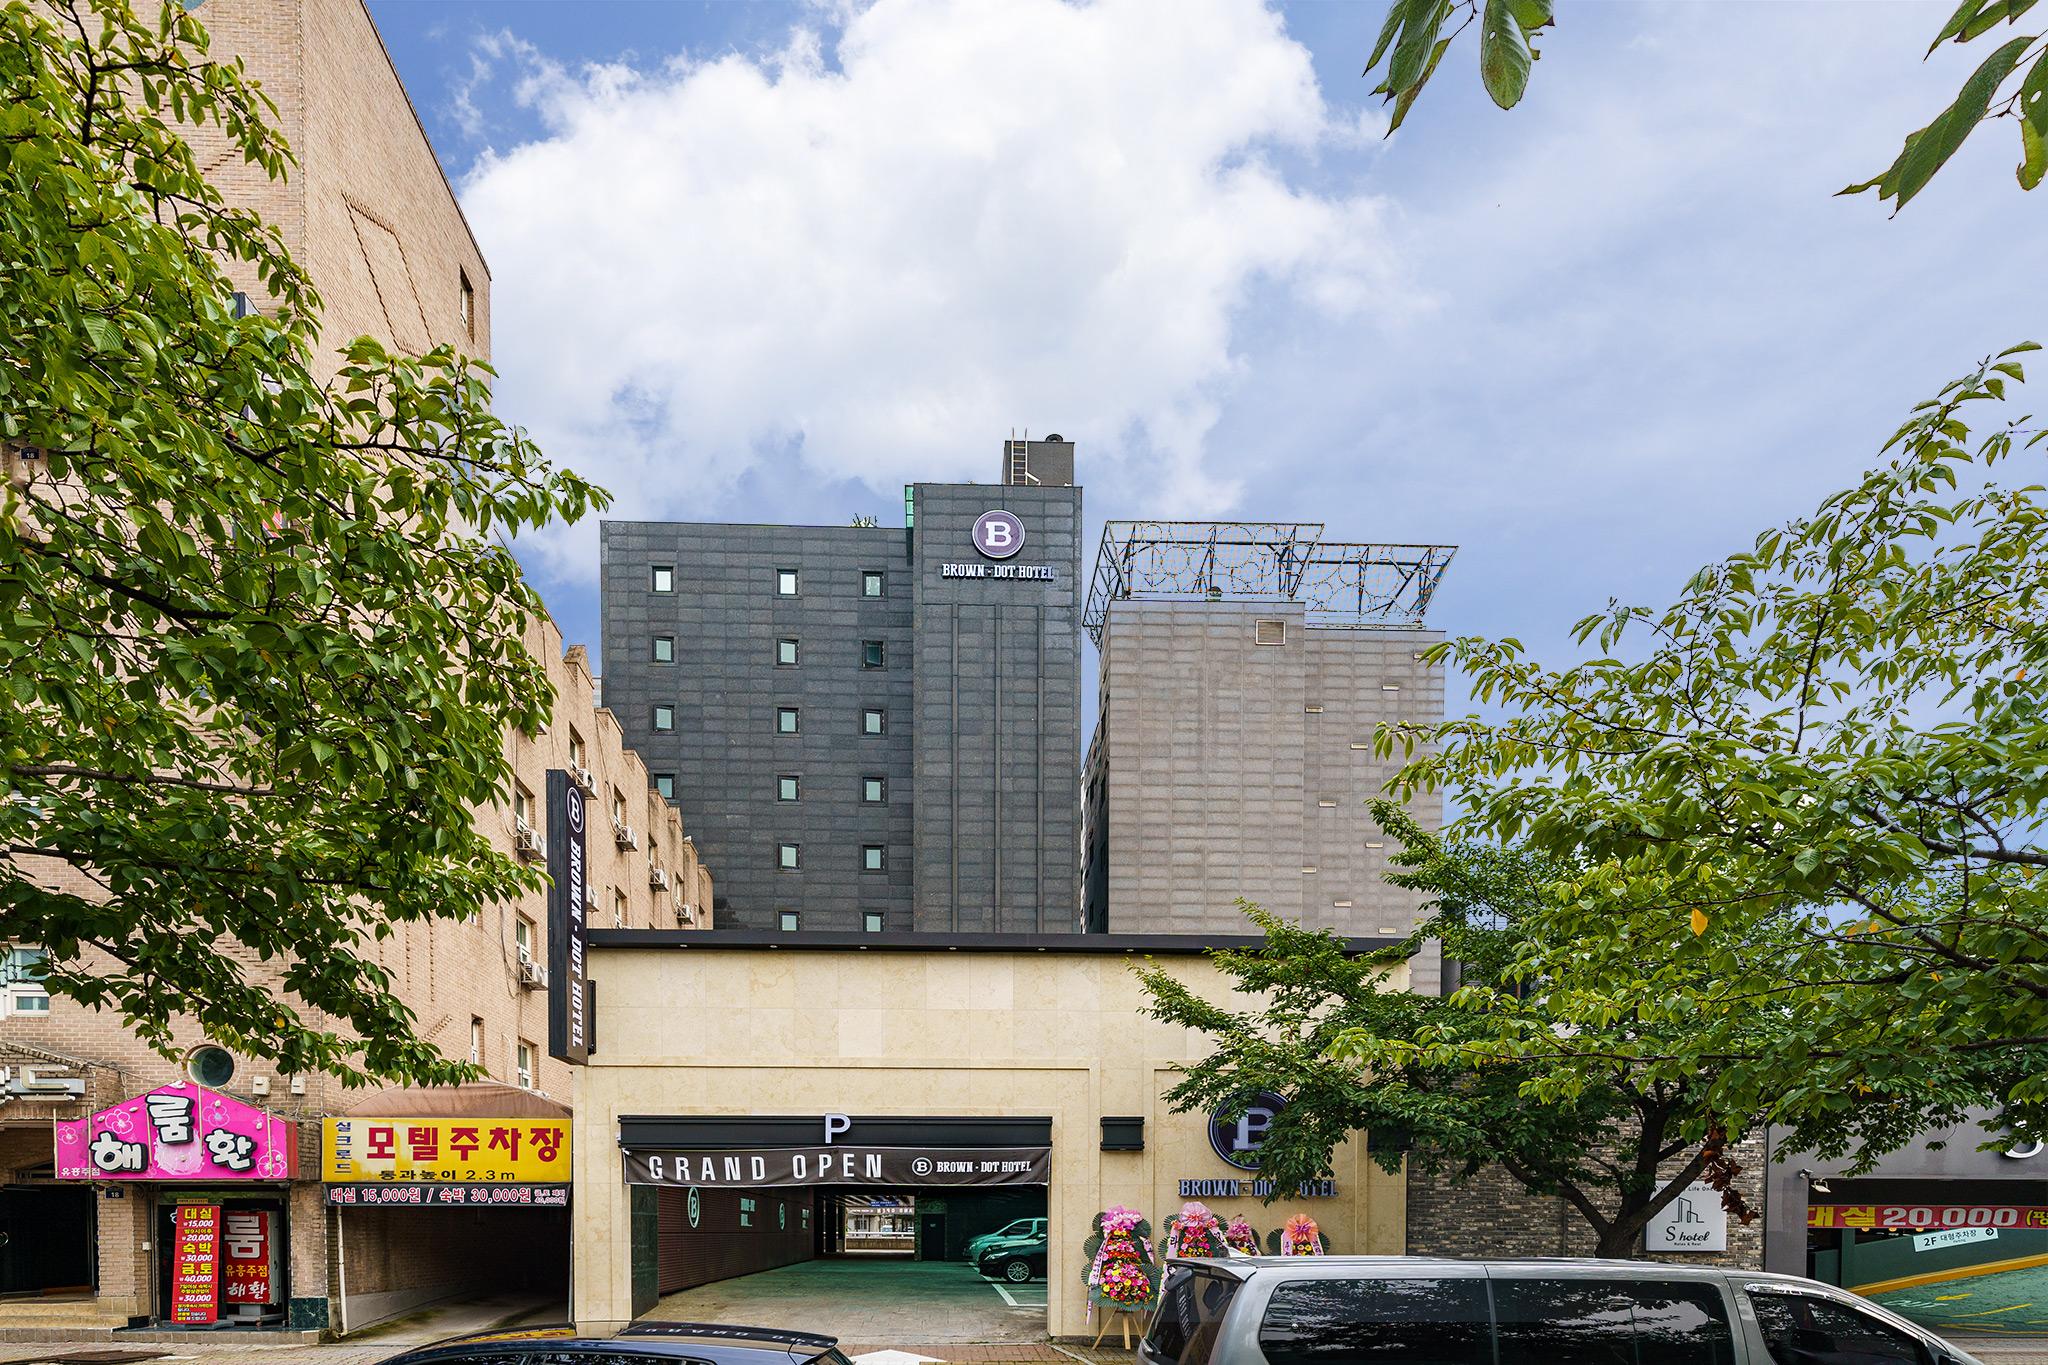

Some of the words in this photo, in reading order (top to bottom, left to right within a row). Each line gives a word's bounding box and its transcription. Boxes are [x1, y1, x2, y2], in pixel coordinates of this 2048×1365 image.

[985, 521, 1012, 547] B
[942, 563, 985, 577] BROWN
[993, 564, 1015, 578] DOT
[1018, 565, 1054, 579] HOTEL
[570, 836, 582, 924] BROWN
[571, 934, 583, 980] DOT
[571, 980, 583, 1047] HOTEL
[825, 1113, 851, 1144] P
[335, 1121, 352, 1173] 실크로드
[366, 1127, 564, 1162] 모텔주차장
[61, 1167, 100, 1176] 유흥주점
[379, 1169, 456, 1181] 통과높이
[649, 1155, 766, 1181] GRAND
[792, 1153, 882, 1179] OPEN
[936, 1161, 973, 1173] BROWN
[981, 1161, 999, 1173] DOT
[1001, 1160, 1032, 1173] HOTEL
[330, 1187, 357, 1203] 대실
[362, 1186, 422, 1204] 15,000원
[439, 1187, 466, 1203] 숙박
[470, 1186, 532, 1204] 30,000원
[1180, 1179, 1239, 1197] BROWN
[184, 1208, 212, 1219] 대실
[224, 1215, 264, 1258] 룸
[1665, 1225, 1676, 1242] S
[1679, 1231, 1710, 1242] hotel
[1923, 1236, 1937, 1247] 2F
[182, 1243, 212, 1254] 숙박
[225, 1264, 268, 1277] 유흥주점
[227, 1281, 267, 1300] 해환
